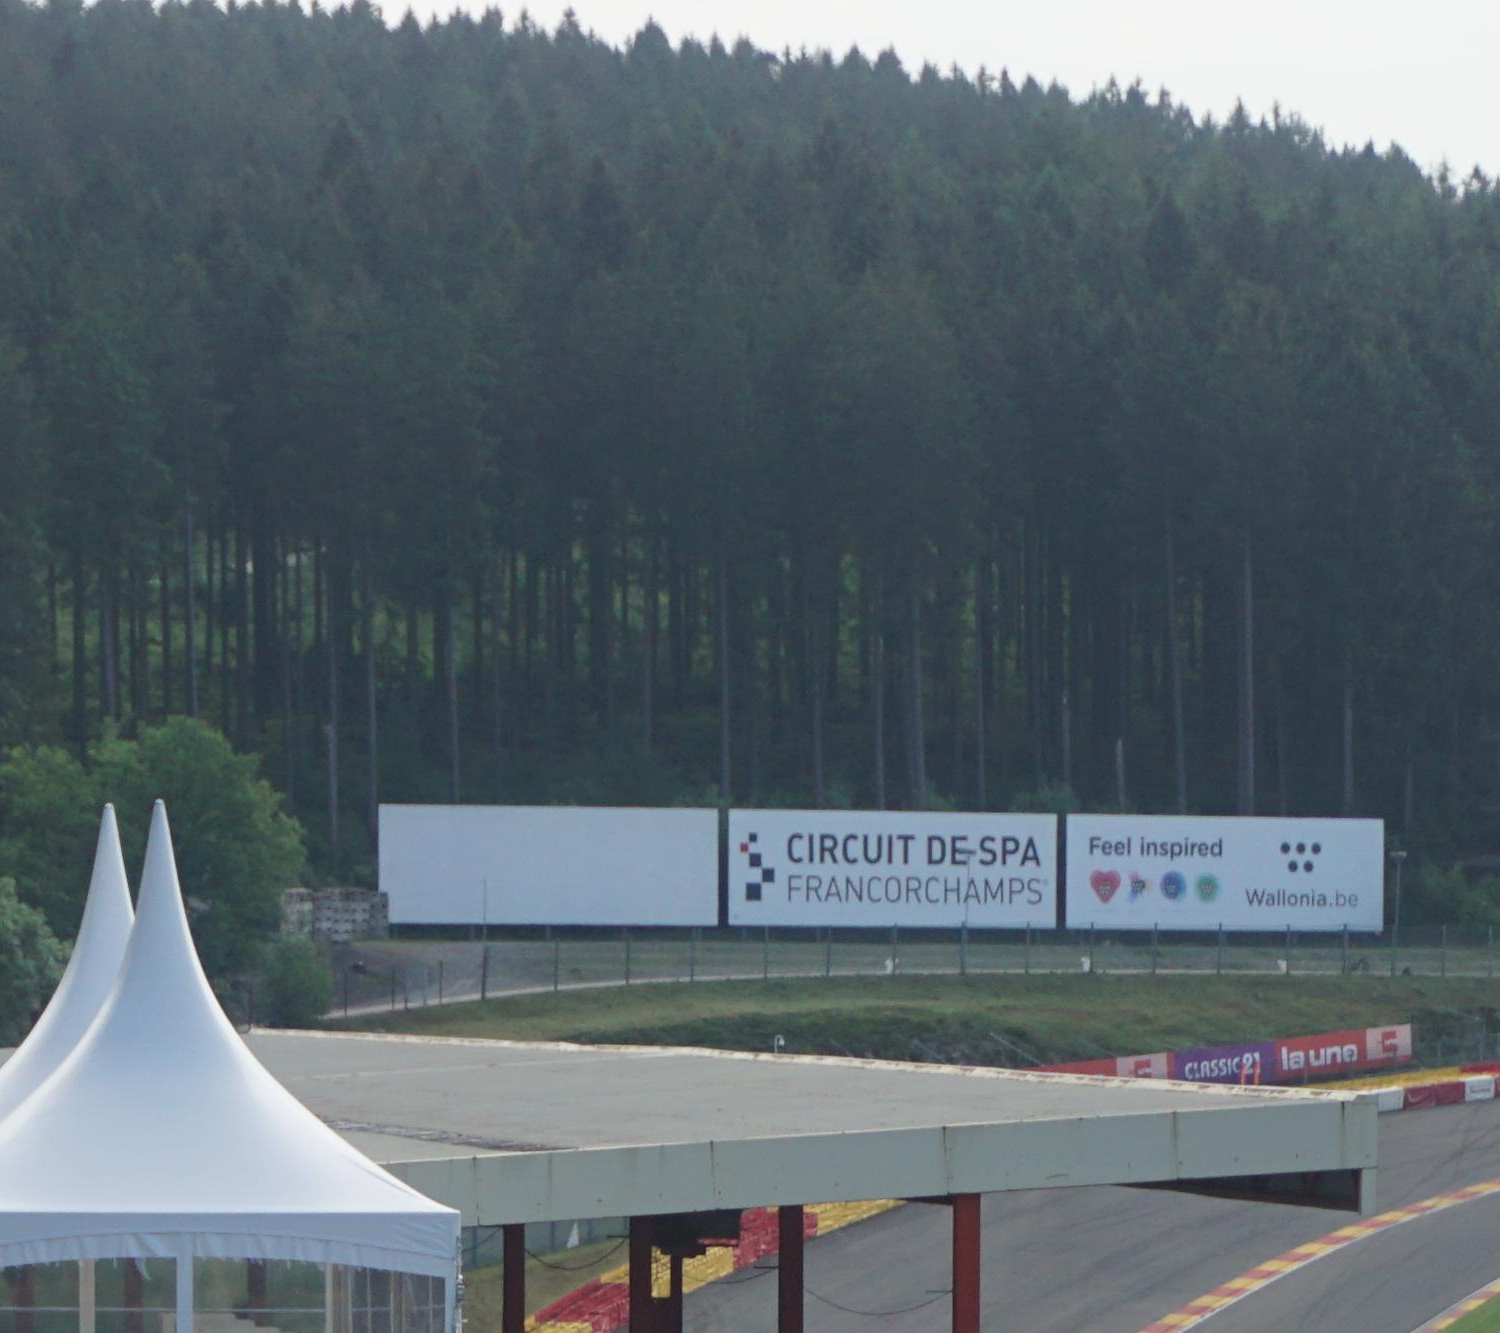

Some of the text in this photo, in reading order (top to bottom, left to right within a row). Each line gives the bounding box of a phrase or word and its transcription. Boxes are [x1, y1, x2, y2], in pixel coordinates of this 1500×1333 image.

[787, 834, 1041, 867] CIRCUIT DE SPA
[1089, 837, 1224, 861] Feel inspired
[787, 874, 1043, 906] FRANCORCHAMPS
[1245, 888, 1359, 908] Wallonia.be
[1281, 1043, 1358, 1071] la une
